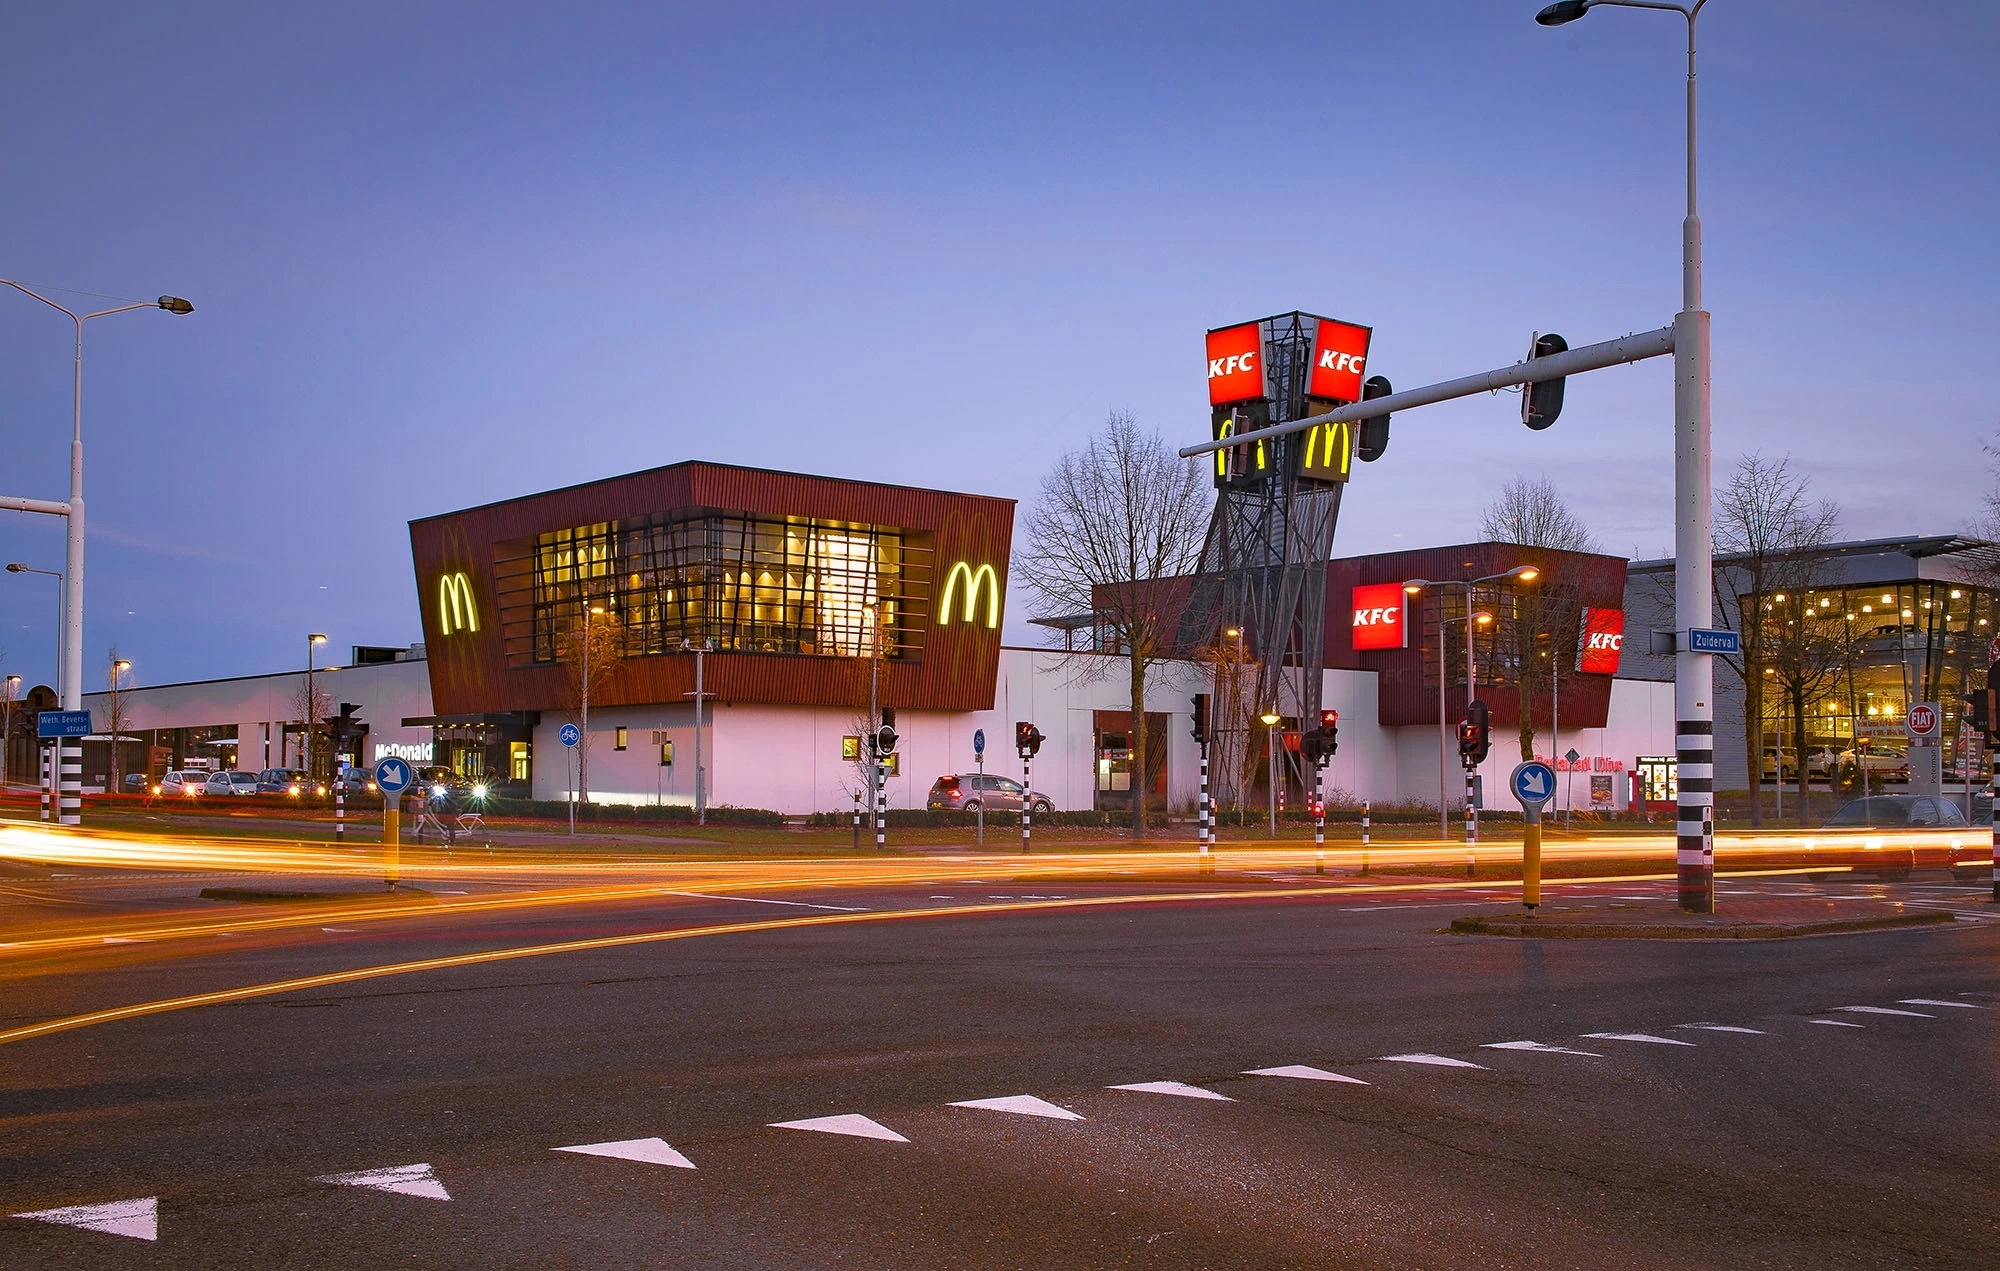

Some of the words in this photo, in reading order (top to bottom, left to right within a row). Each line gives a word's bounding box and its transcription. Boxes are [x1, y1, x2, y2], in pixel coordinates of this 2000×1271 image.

[1208, 351, 1257, 379] KFC
[1319, 349, 1365, 374] KFC
[1353, 606, 1400, 627] KFC
[1588, 632, 1624, 651] KFC
[1696, 634, 1735, 649] Zuiderval
[41, 716, 60, 724] Weth.
[61, 715, 87, 724] Bevers-
[1911, 711, 1932, 725] FIAT
[66, 725, 87, 733] straat
[375, 742, 433, 761] McDonald
[1597, 756, 1623, 772] Drive
